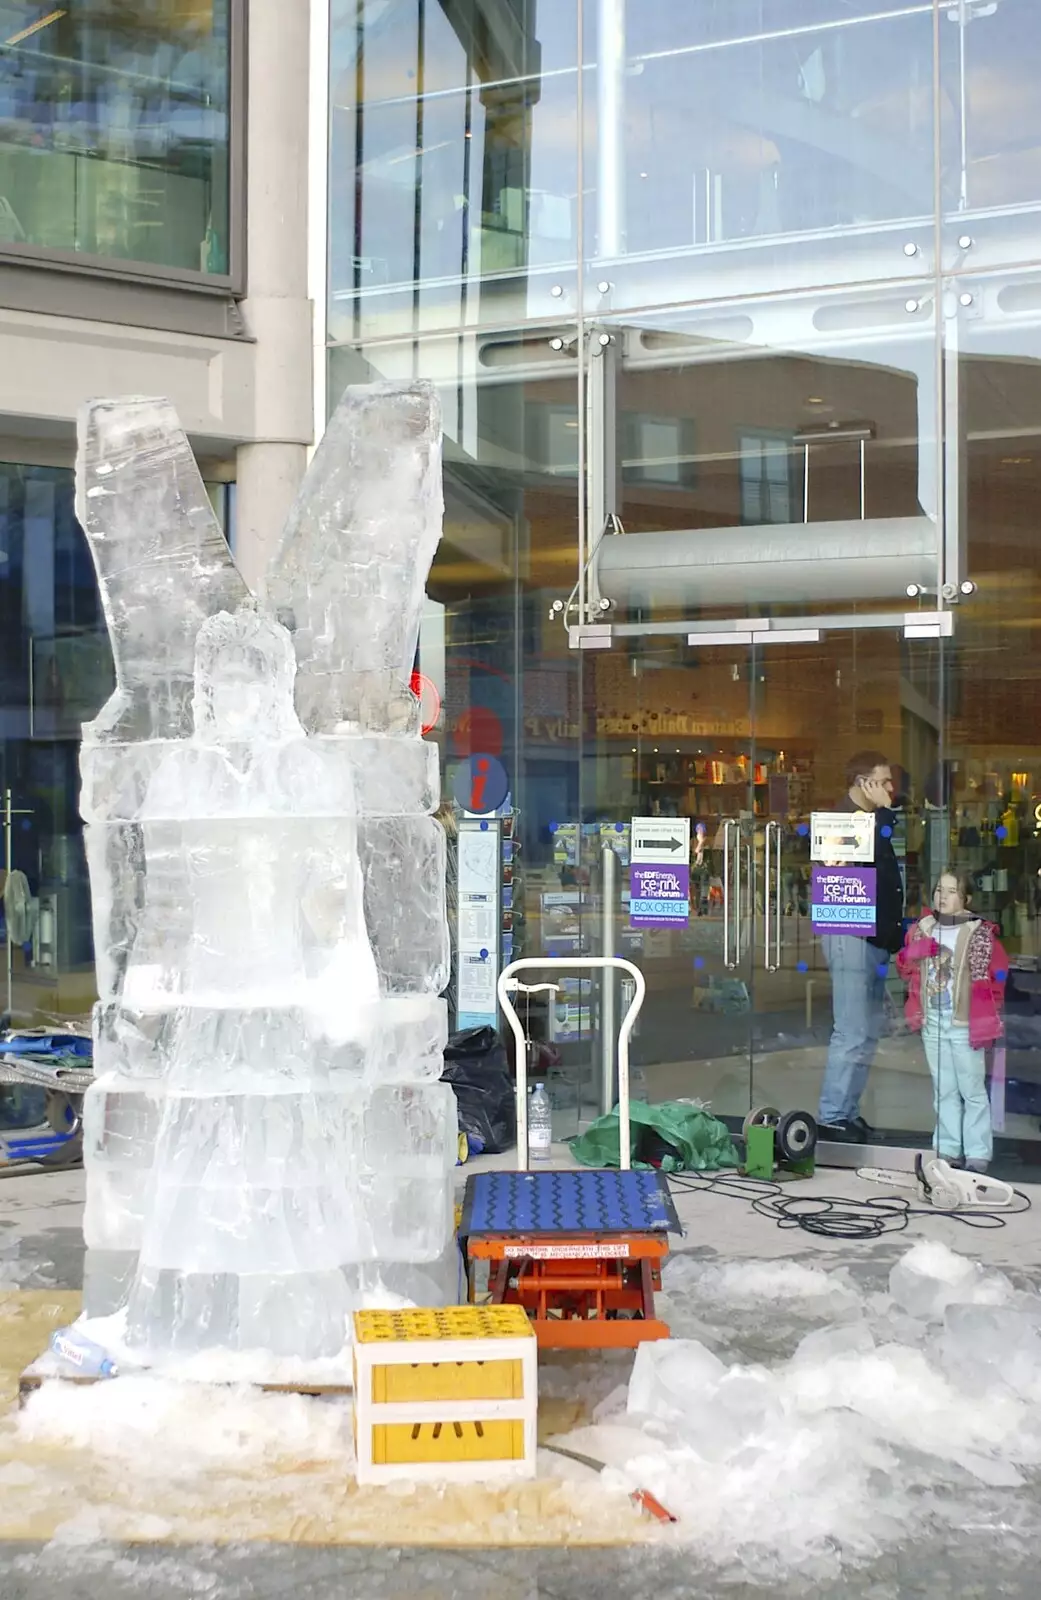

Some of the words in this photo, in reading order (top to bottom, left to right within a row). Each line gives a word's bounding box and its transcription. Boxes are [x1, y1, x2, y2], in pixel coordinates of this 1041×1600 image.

[660, 877, 680, 890] rink
[844, 881, 866, 895] rink
[634, 902, 653, 912] BOX
[654, 902, 685, 913] OFFICE
[816, 908, 837, 918] BOX
[838, 908, 871, 919] OFFICE
